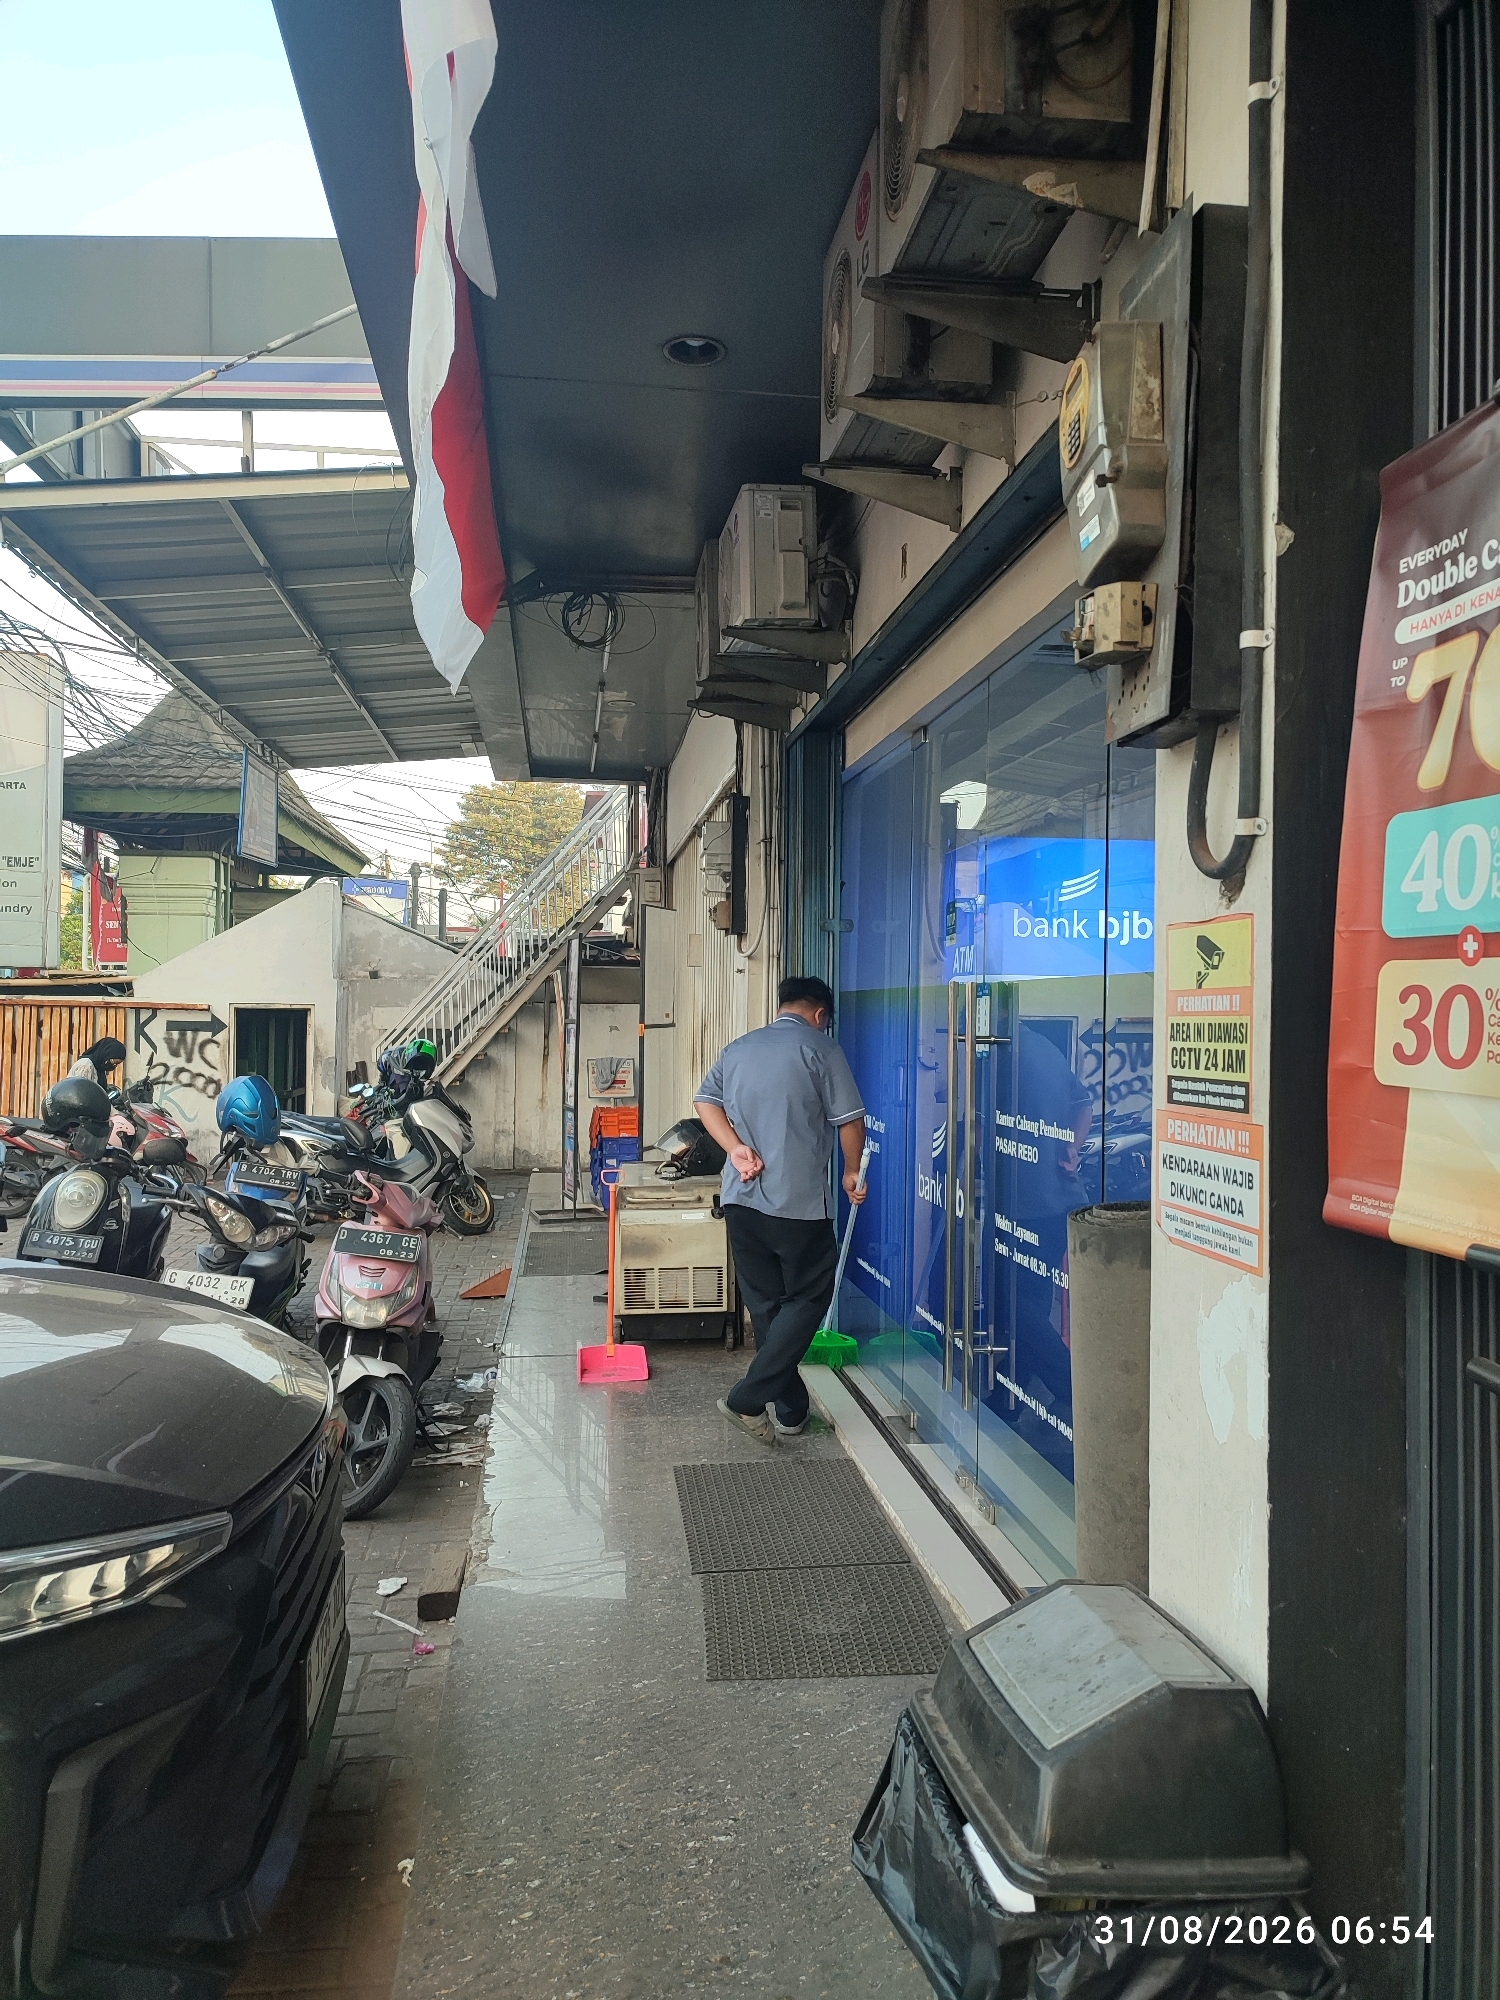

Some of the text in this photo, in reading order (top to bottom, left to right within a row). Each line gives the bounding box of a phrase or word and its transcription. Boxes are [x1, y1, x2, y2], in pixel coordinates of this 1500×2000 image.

[1399, 528, 1468, 574] EVERYDAY
[1397, 538, 1500, 609] Double C
[1410, 608, 1452, 636] HANYA
[1455, 605, 1466, 618] DI
[1392, 657, 1408, 670] UP
[1390, 675, 1406, 688] TO
[2, 856, 40, 868] "EMJE"
[1401, 824, 1491, 913] 40
[1013, 908, 1153, 946] bank bjb
[953, 945, 974, 974] ATM
[1177, 994, 1230, 1012] PERHATIAN
[1170, 1022, 1249, 1045] AREA INI DIAWASI
[1392, 983, 1484, 1070] 30
[163, 1030, 221, 1071] WC
[1171, 1046, 1246, 1074] CCTV 24 JAM
[996, 1109, 1074, 1143] Kantor Cabang Pembantu
[1167, 1118, 1250, 1154] PERHATIAN !!!
[995, 1135, 1038, 1164] PASAR REBO
[240, 1163, 247, 1172] B
[252, 1166, 276, 1176] 4704
[918, 1163, 942, 1208] bank
[1162, 1153, 1254, 1190] KENDARAAN WAJIB
[1170, 1181, 1245, 1218] DIKUNCI GANDA
[32, 1233, 40, 1242] B
[339, 1229, 348, 1240] D
[360, 1231, 392, 1245] 4367
[995, 1212, 1039, 1247] Waktu Layanan
[1164, 1211, 1254, 1248] Segala macam bentuk kehilangan bukan
[1174, 1227, 1192, 1240] menjadi
[1192, 1232, 1213, 1248] tanggung
[1213, 1238, 1228, 1252] jawab
[995, 1238, 1009, 1258] Senin
[1013, 1247, 1029, 1269] Jumat
[1052, 1266, 1069, 1290] 15.30
[187, 1274, 221, 1290] 4032
